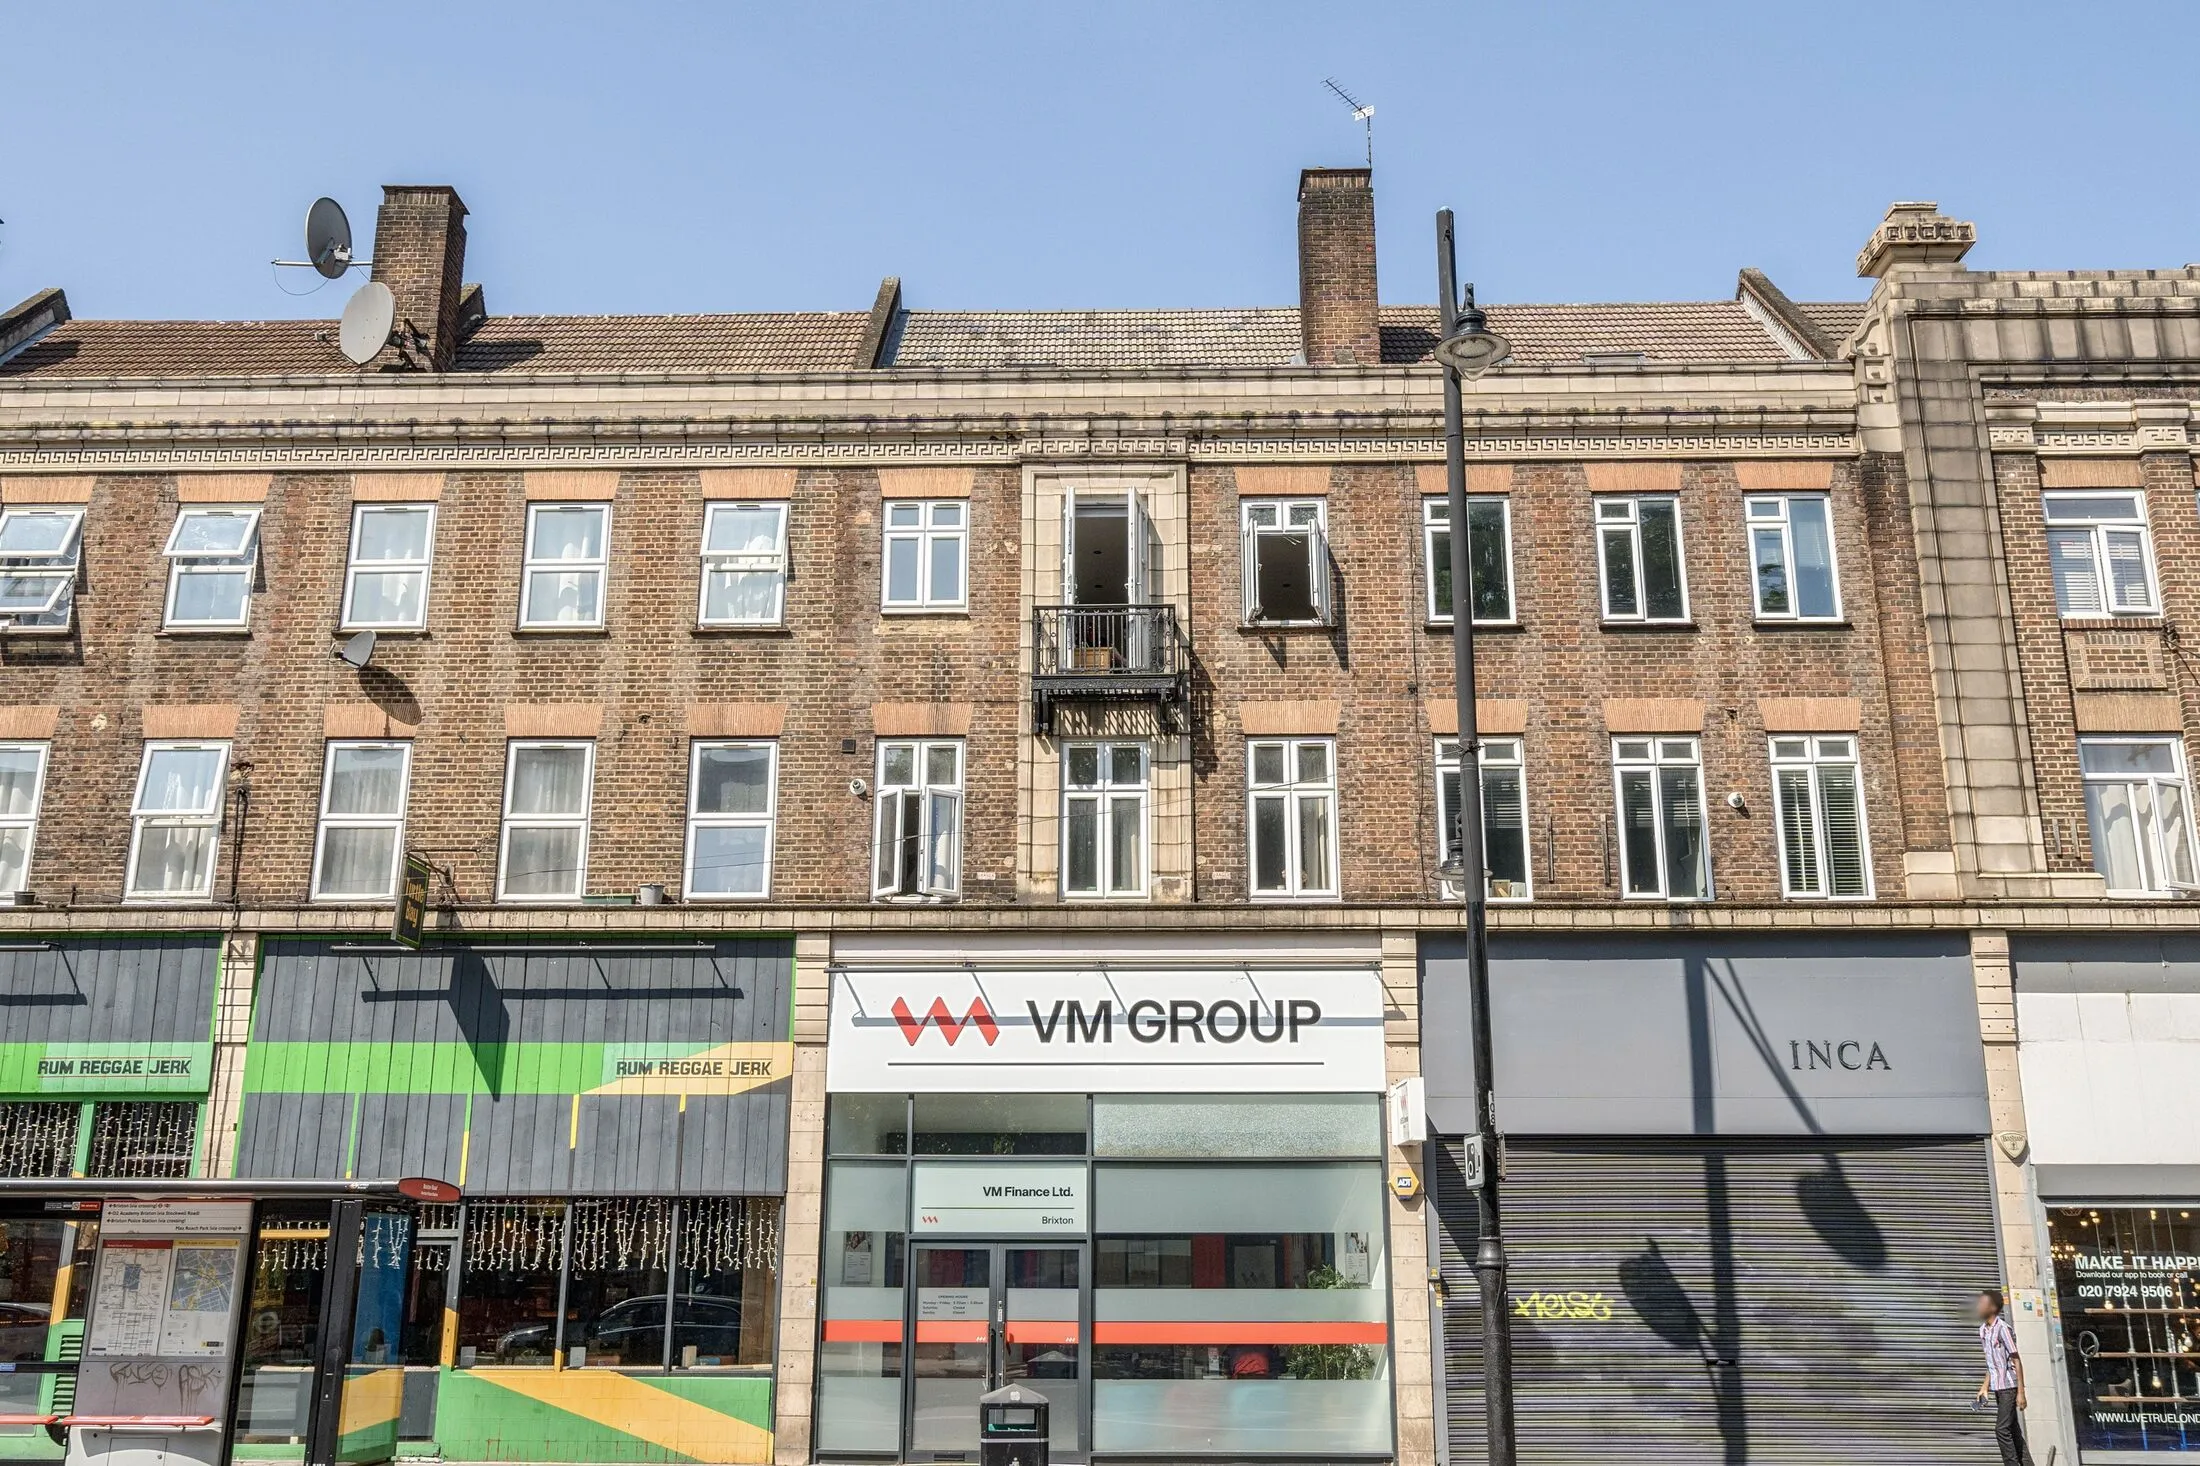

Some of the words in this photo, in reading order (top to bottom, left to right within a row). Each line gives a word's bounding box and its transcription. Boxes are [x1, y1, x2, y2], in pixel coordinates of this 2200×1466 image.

[1026, 1000, 1113, 1044] VM
[1127, 999, 1322, 1044] GROUP
[1789, 1039, 1893, 1070] INCA
[37, 1060, 74, 1075] RUM
[79, 1060, 143, 1075] REGGAE
[150, 1060, 192, 1074] JERK
[616, 1061, 652, 1075] RUM
[658, 1061, 723, 1075] REGGAE
[730, 1061, 772, 1075] JERK
[1397, 1178, 1411, 1187] ADT
[982, 1186, 1002, 1197] VM
[1004, 1186, 1050, 1197] Finance
[1052, 1186, 1074, 1197] Ltd.
[1041, 1216, 1074, 1225] Brixton
[2074, 1256, 2124, 1270] MAKE
[2131, 1256, 2148, 1270] IT
[2076, 1270, 2111, 1278] Download
[2078, 1285, 2103, 1297] 020
[2105, 1285, 2138, 1297] 7924
[2141, 1285, 2173, 1297] 9506
